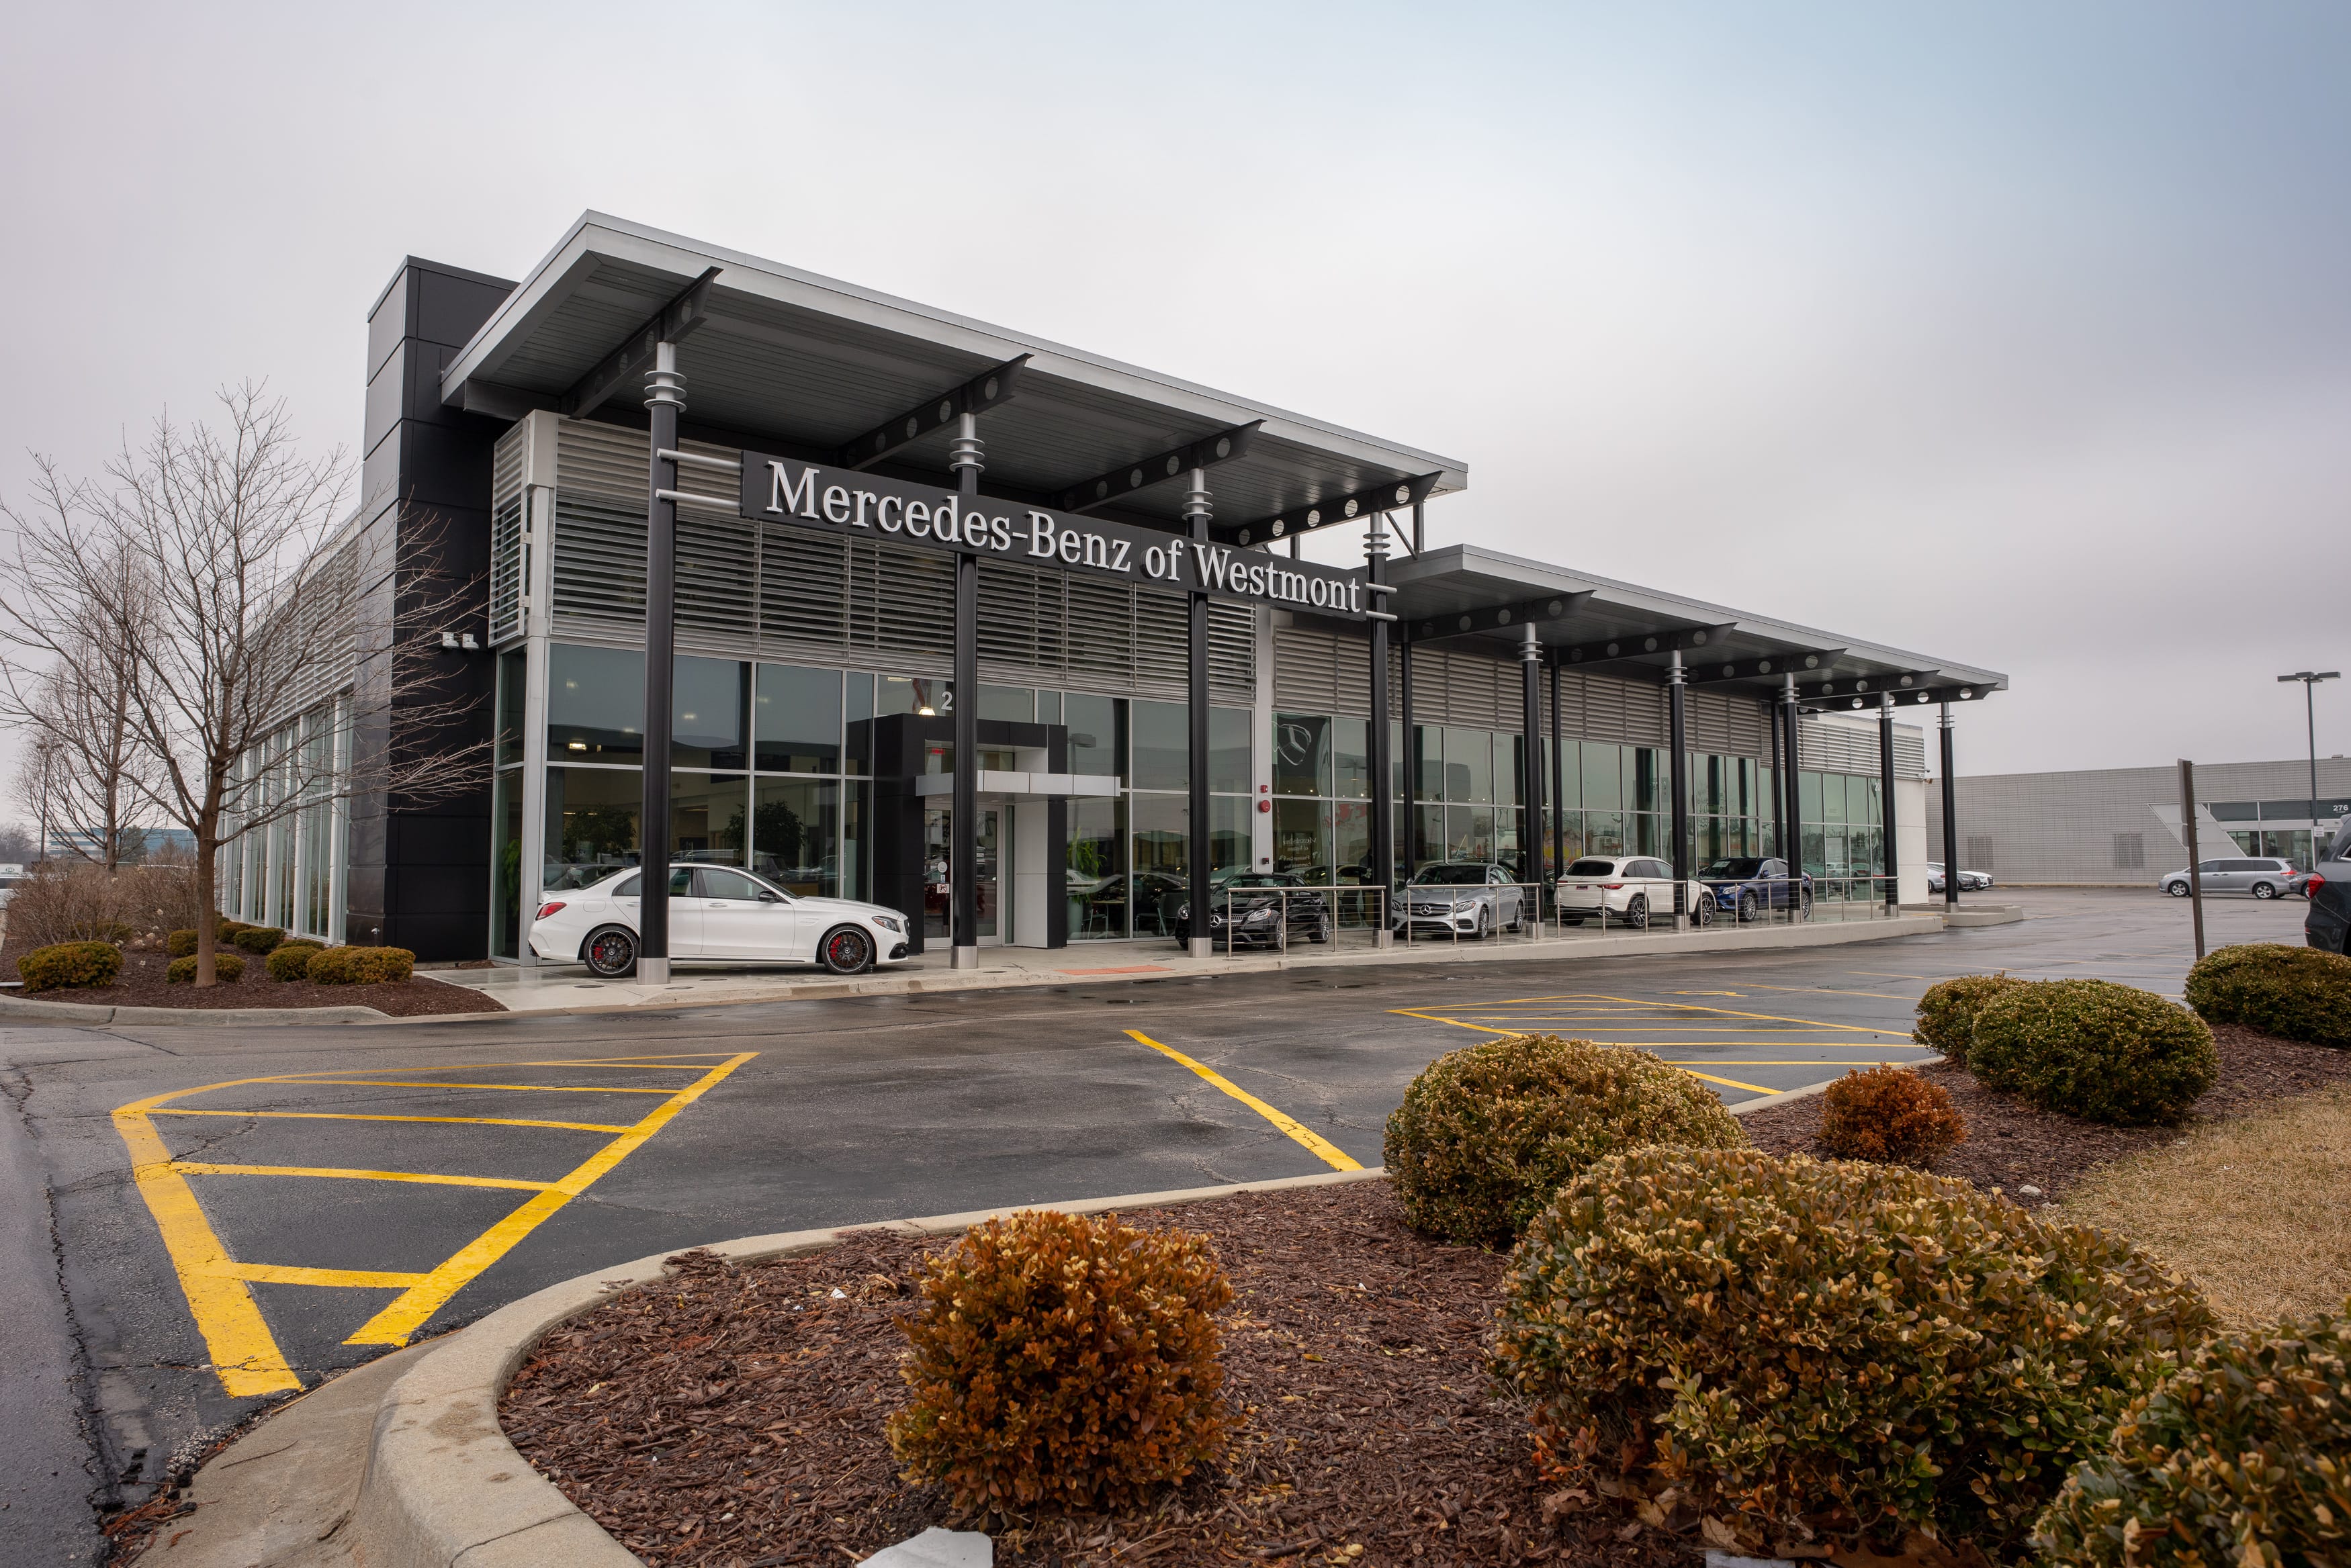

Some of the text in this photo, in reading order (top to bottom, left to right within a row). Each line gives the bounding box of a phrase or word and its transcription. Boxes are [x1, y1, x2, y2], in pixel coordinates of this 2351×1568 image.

[766, 460, 1360, 613] Mercedes-Benz of Westmont
